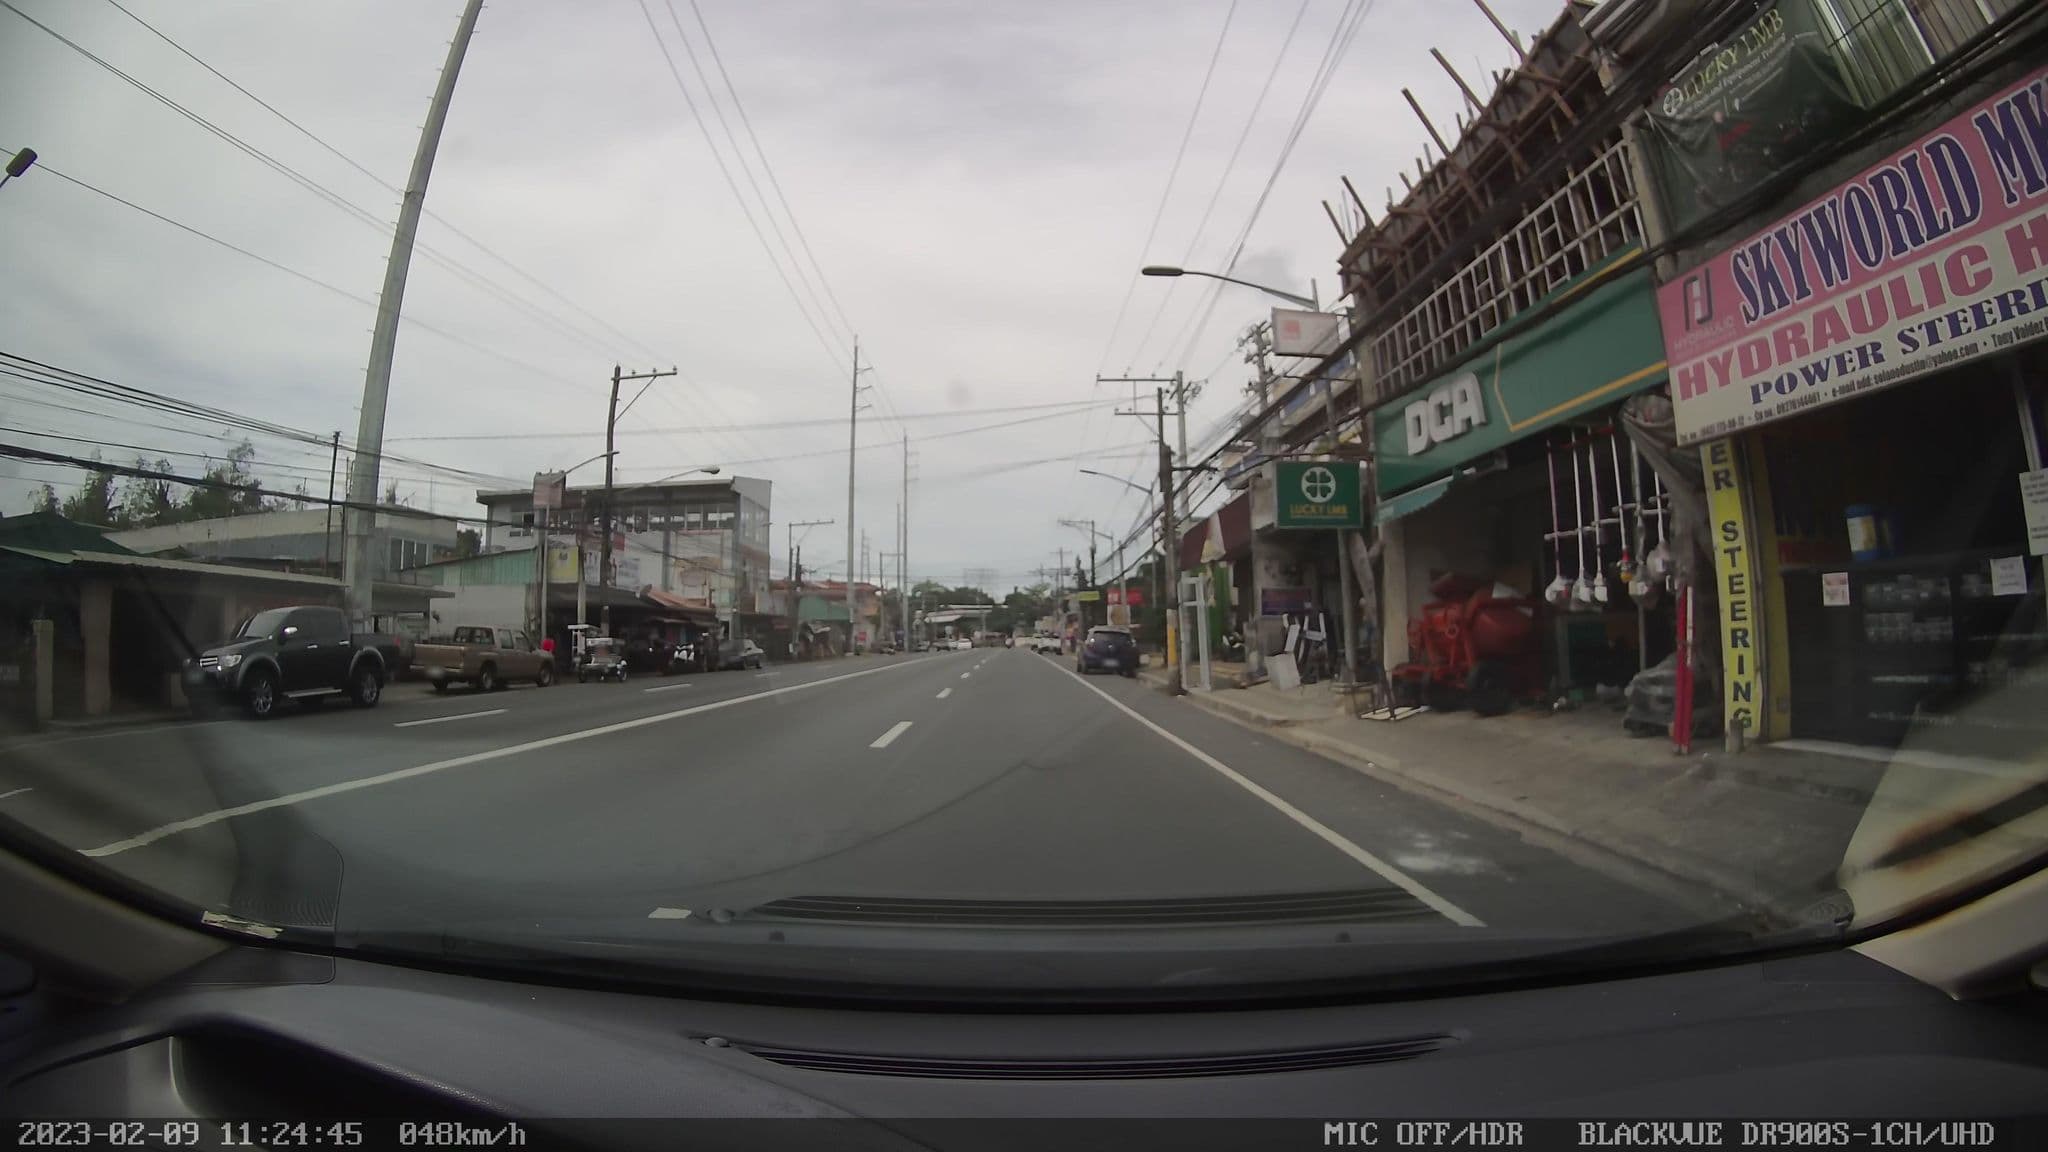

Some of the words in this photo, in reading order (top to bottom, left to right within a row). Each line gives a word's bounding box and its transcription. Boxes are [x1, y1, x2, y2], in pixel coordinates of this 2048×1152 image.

[1731, 133, 1983, 326] SKYWORLD
[1678, 245, 1994, 401] HYDRAULIC
[1750, 340, 1886, 405] POWER
[1896, 278, 2048, 357] STEERI
[1404, 371, 1488, 456] DCA
[1720, 519, 1753, 729] STEERING
